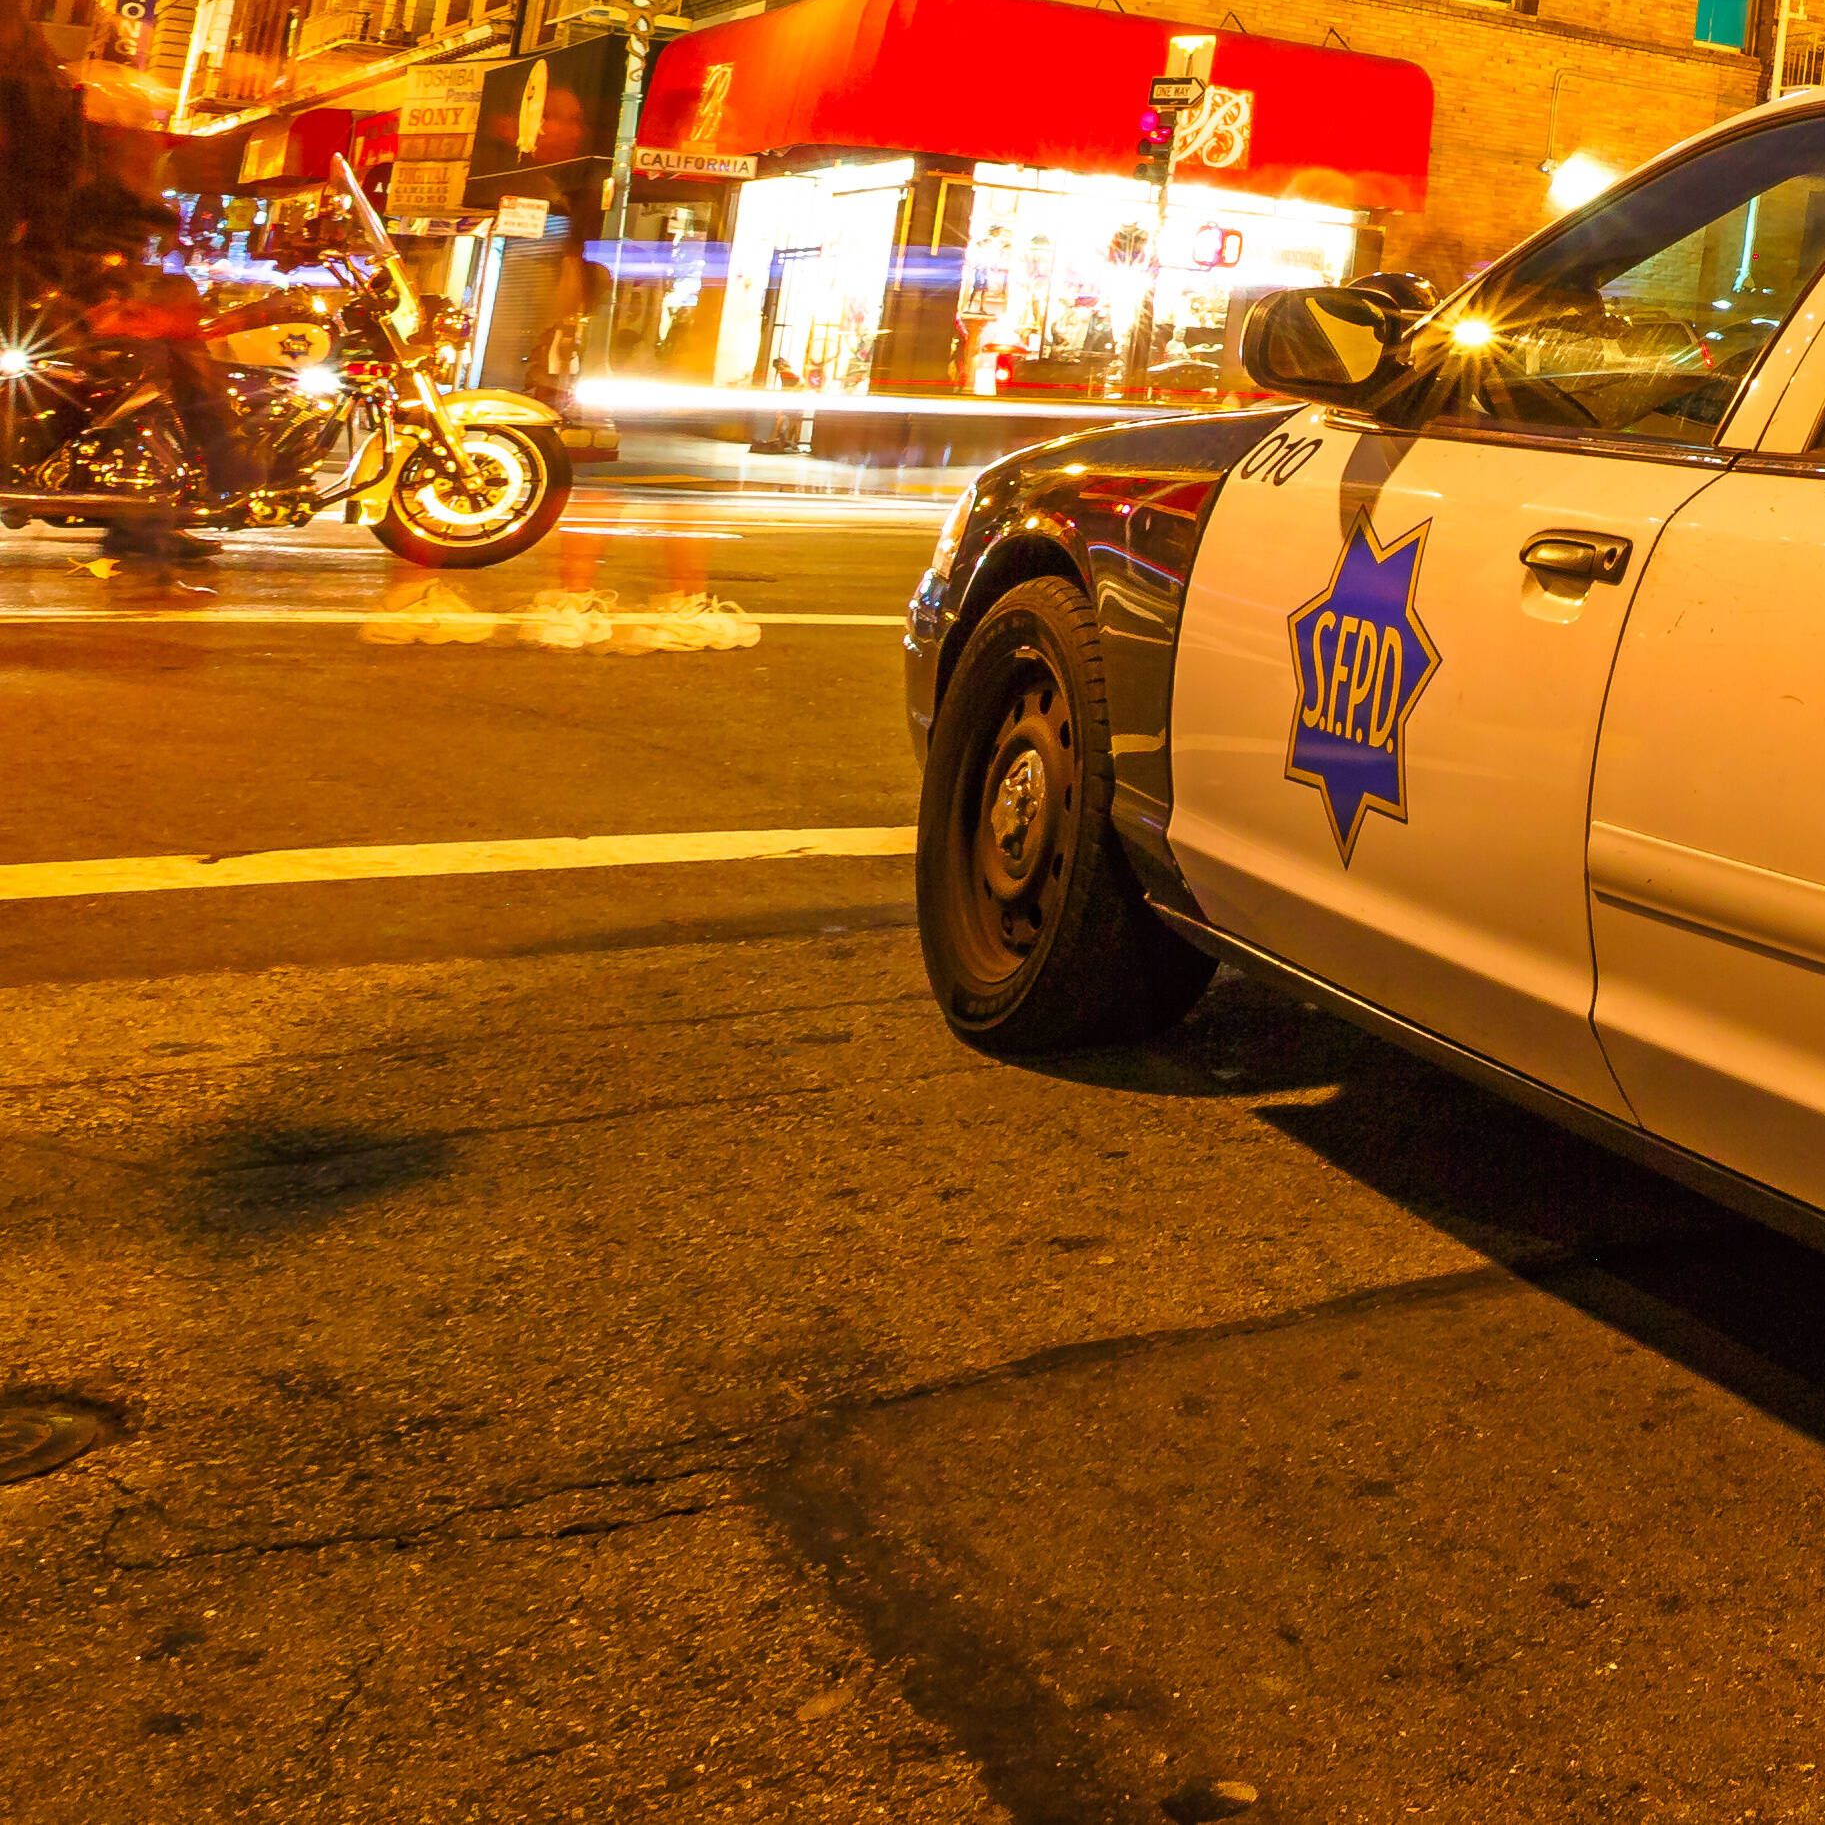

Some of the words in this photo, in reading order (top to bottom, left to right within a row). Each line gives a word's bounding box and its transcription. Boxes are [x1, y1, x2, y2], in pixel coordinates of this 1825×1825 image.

[415, 68, 474, 88] TOSHIBA
[1155, 84, 1172, 97] ONE
[1173, 86, 1190, 97] WAY
[408, 107, 465, 127] SONY
[640, 152, 750, 173] CALIFORNIA
[1241, 432, 1323, 487] 010
[1303, 610, 1404, 755] S.F.P.D.
